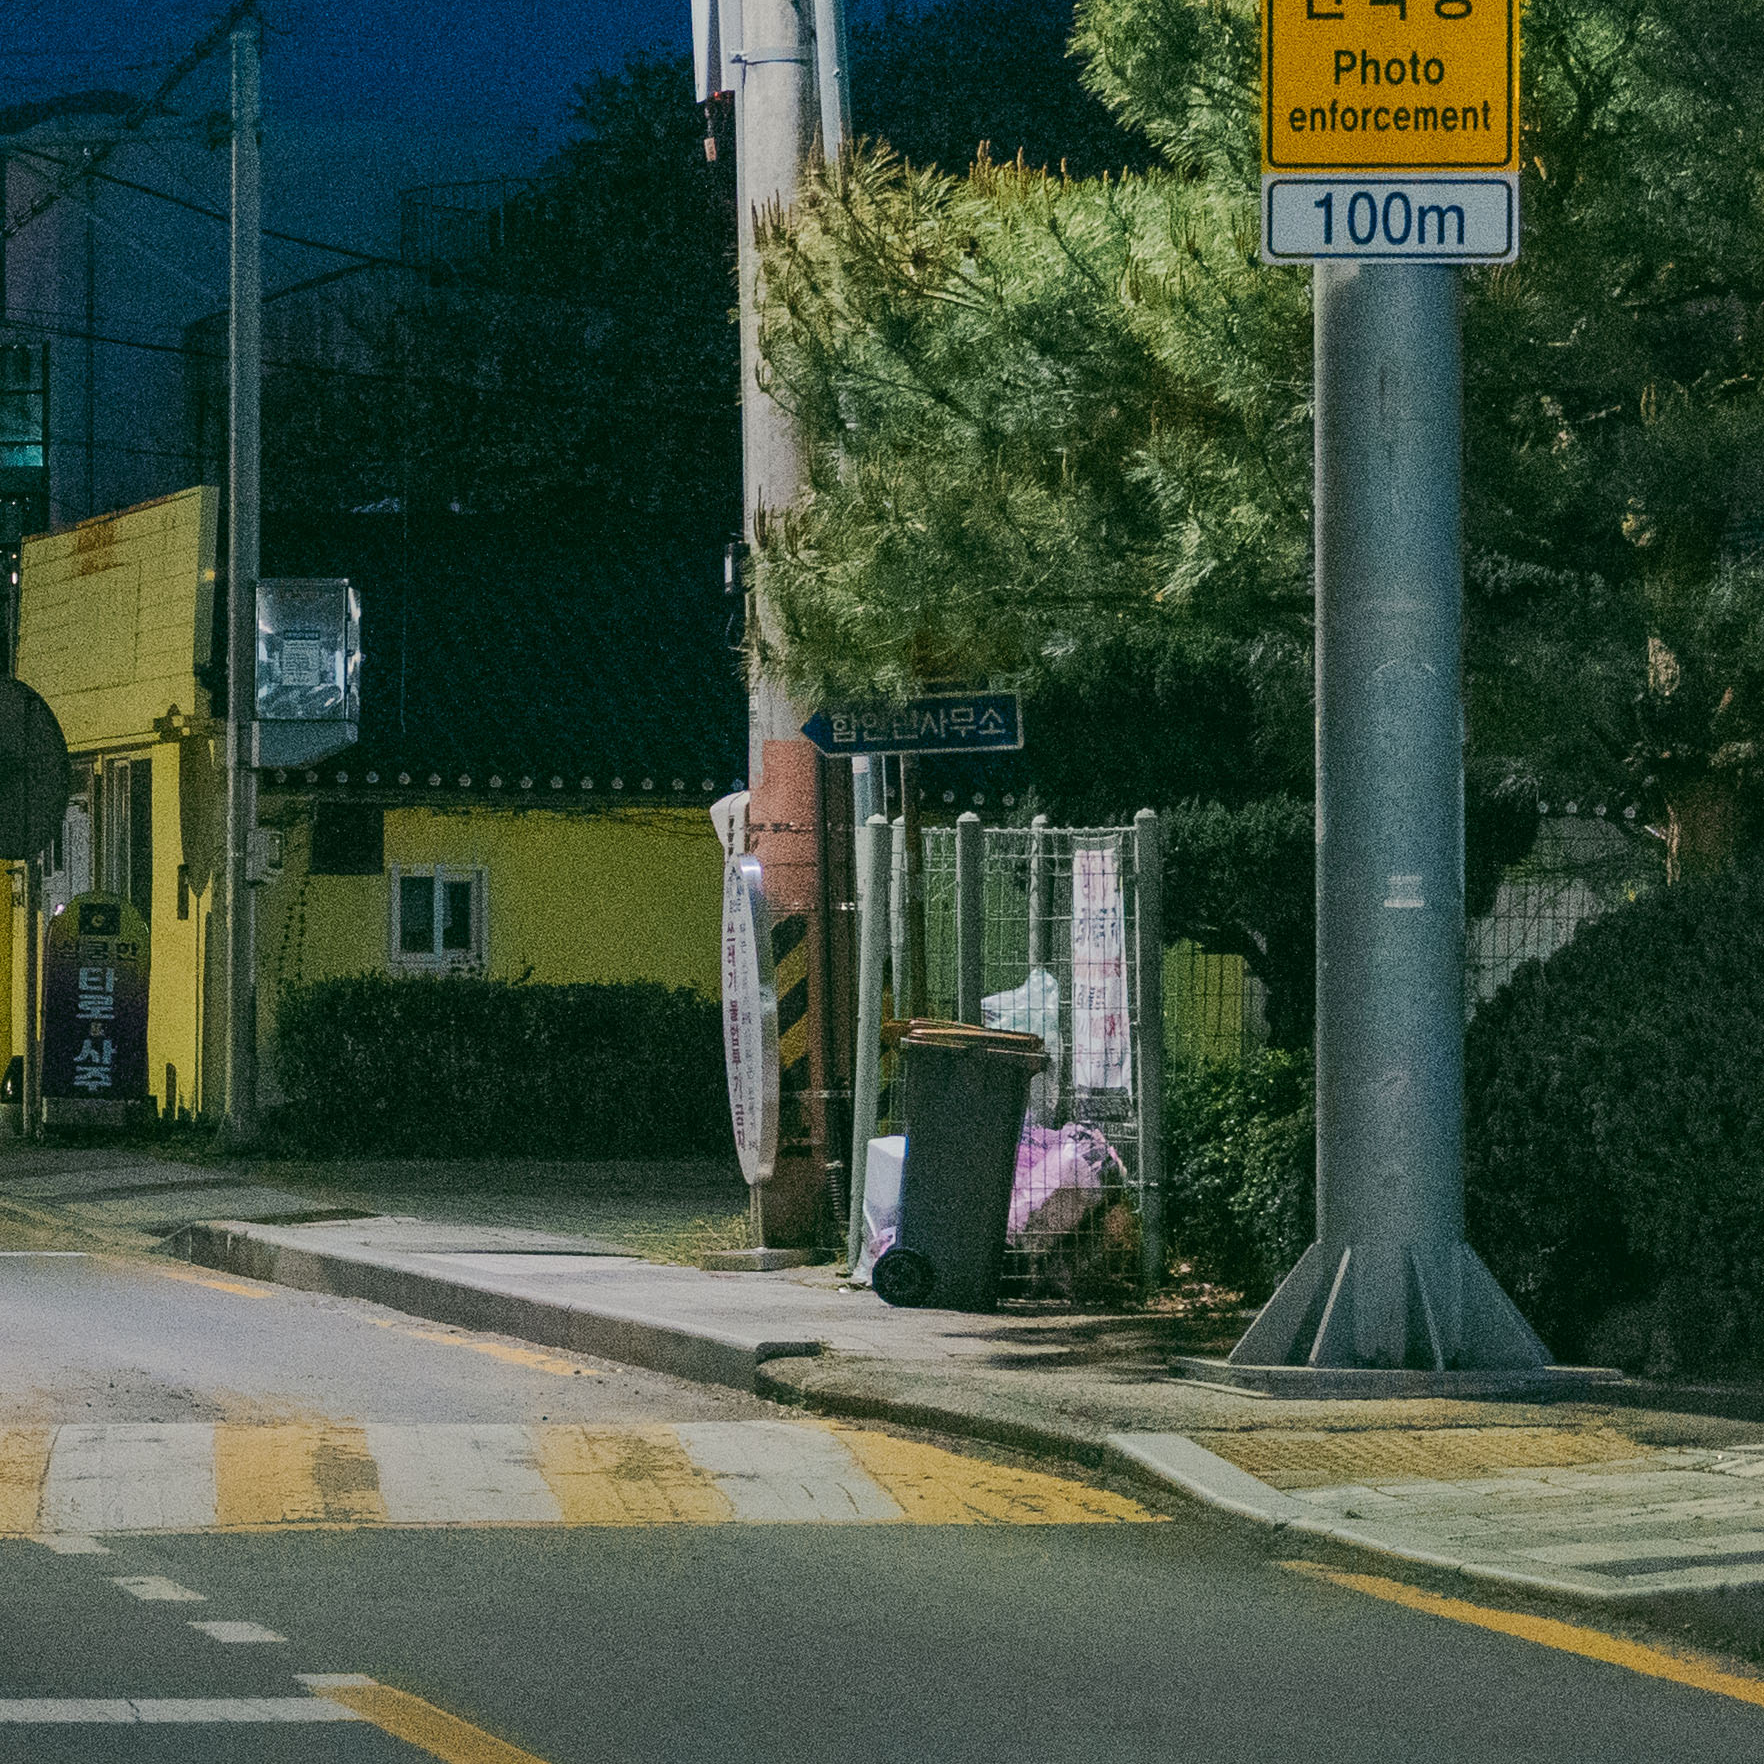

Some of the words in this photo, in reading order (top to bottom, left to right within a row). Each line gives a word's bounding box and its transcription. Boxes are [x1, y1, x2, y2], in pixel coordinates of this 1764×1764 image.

[1333, 49, 1445, 86] Photo
[1288, 98, 1492, 132] enforcement
[1313, 190, 1466, 246] 100m
